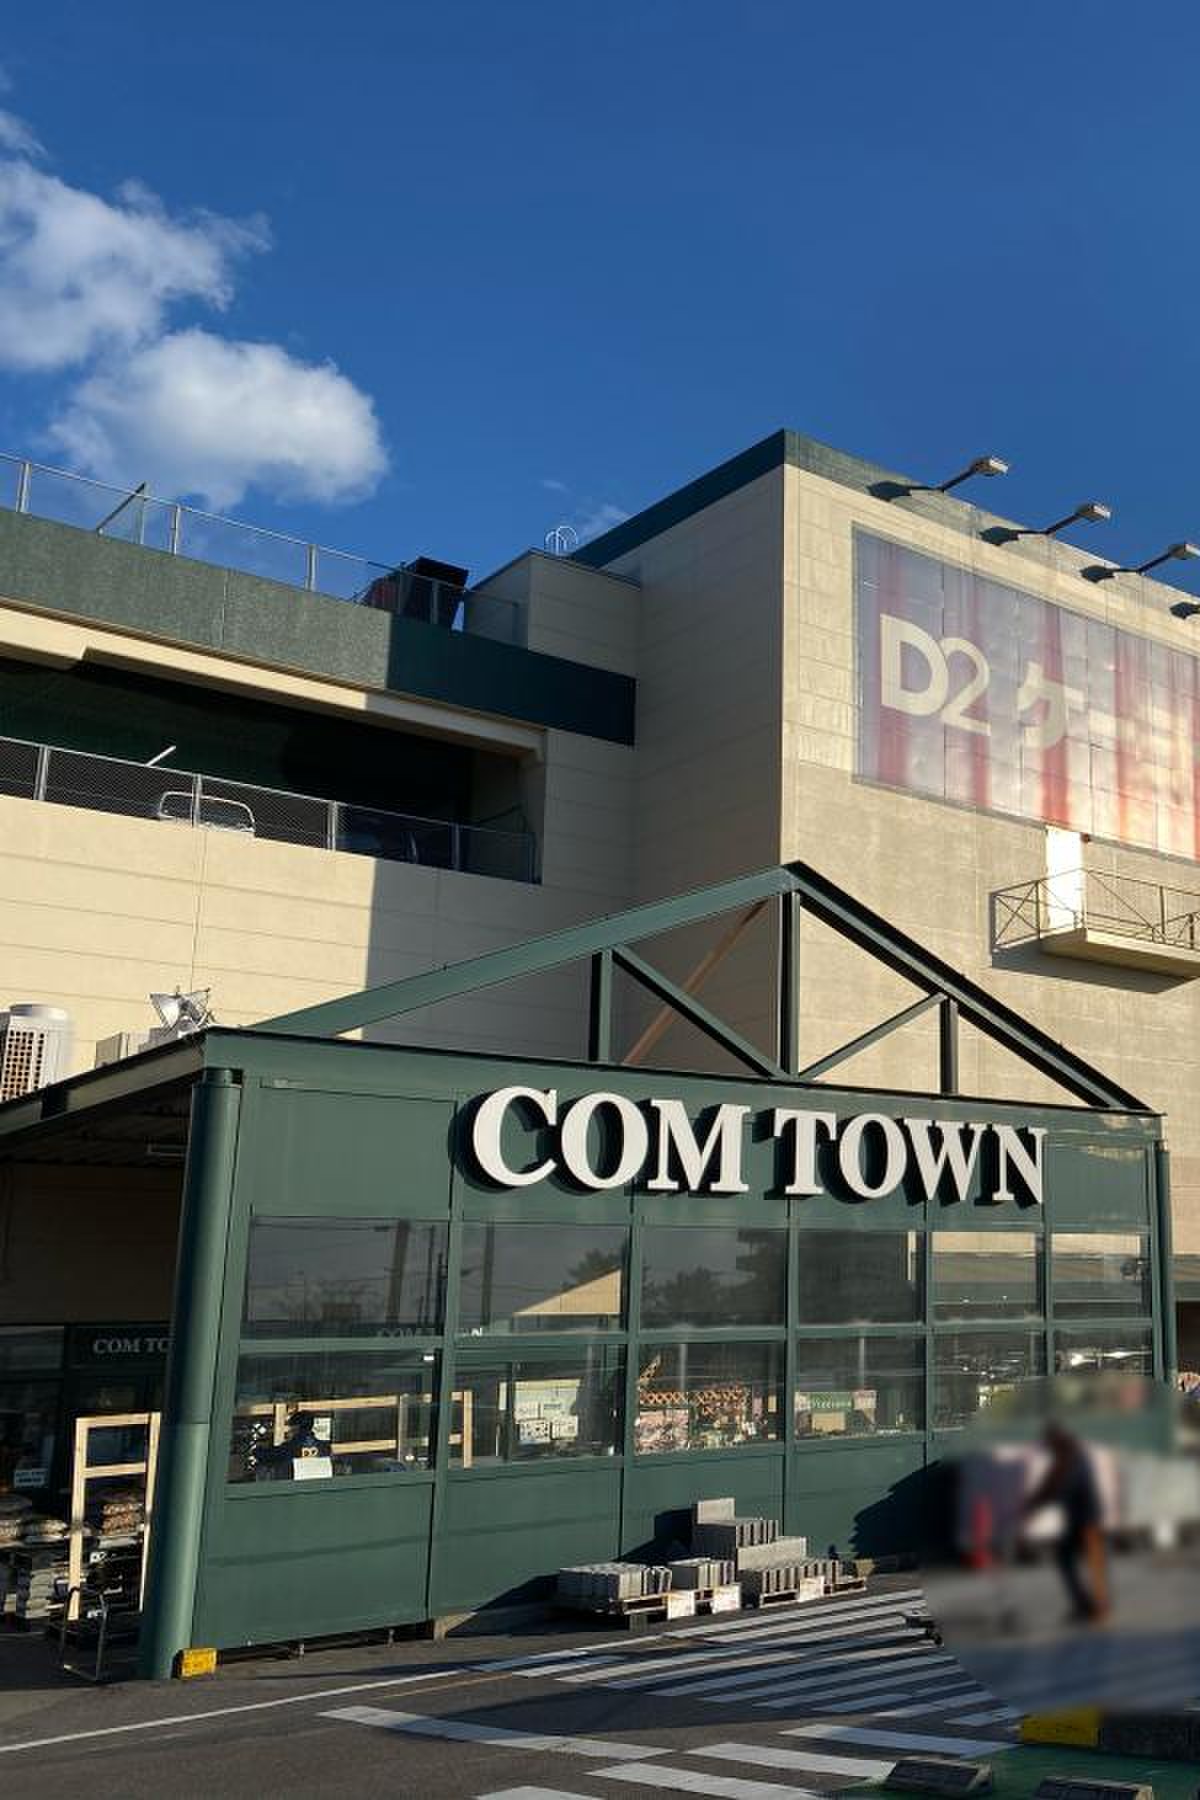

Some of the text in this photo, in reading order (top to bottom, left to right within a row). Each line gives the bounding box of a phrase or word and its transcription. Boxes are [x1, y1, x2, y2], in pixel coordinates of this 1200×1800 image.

[880, 613, 992, 736] D2
[472, 1086, 1047, 1204] COM TOWN
[93, 1338, 142, 1355] COM
